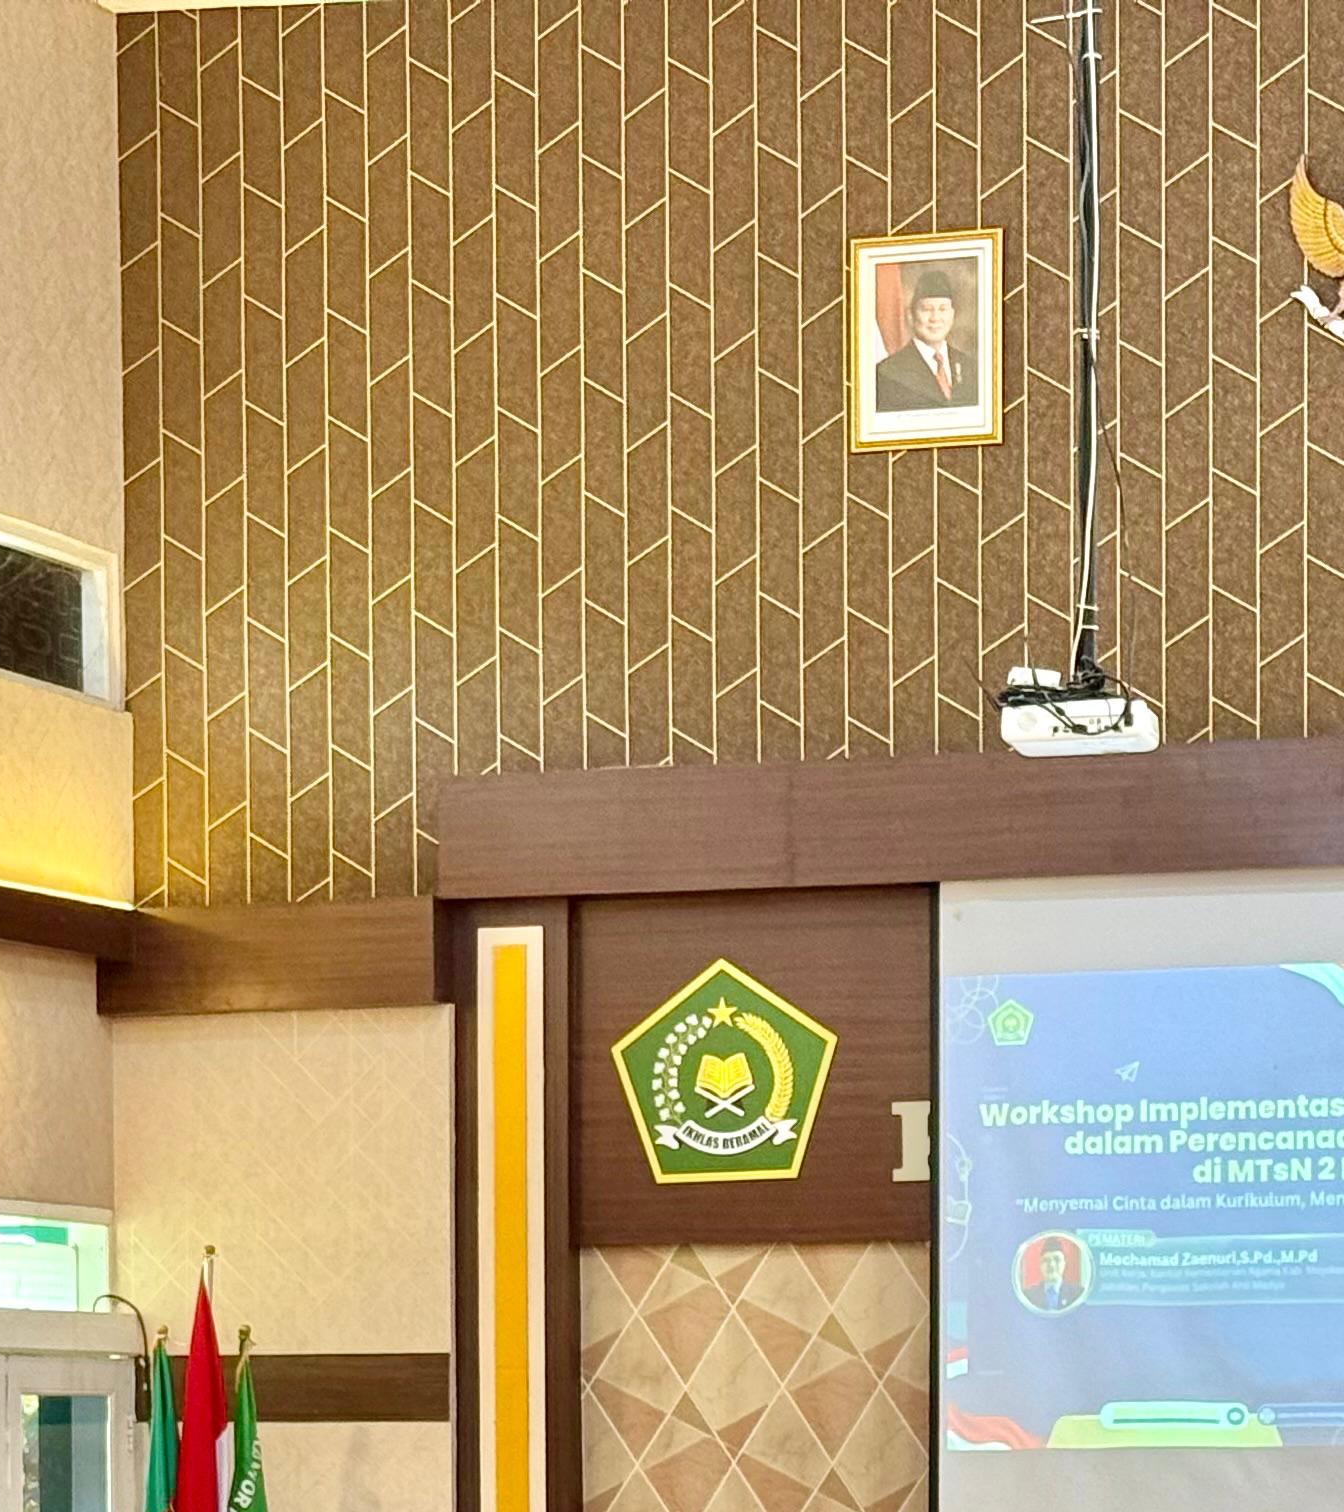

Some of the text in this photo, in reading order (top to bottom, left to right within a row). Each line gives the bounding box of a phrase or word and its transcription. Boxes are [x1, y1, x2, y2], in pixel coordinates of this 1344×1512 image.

[979, 1099, 1134, 1130] Workshop
[1064, 1130, 1163, 1155] dalam
[1193, 1158, 1222, 1184] di
[1227, 1157, 1313, 1183] MTsN
[1317, 1157, 1336, 1181] 2
[1112, 1194, 1157, 1211] Cinta
[1160, 1193, 1212, 1211] dalam
[1215, 1191, 1306, 1210] Kurikulum,
